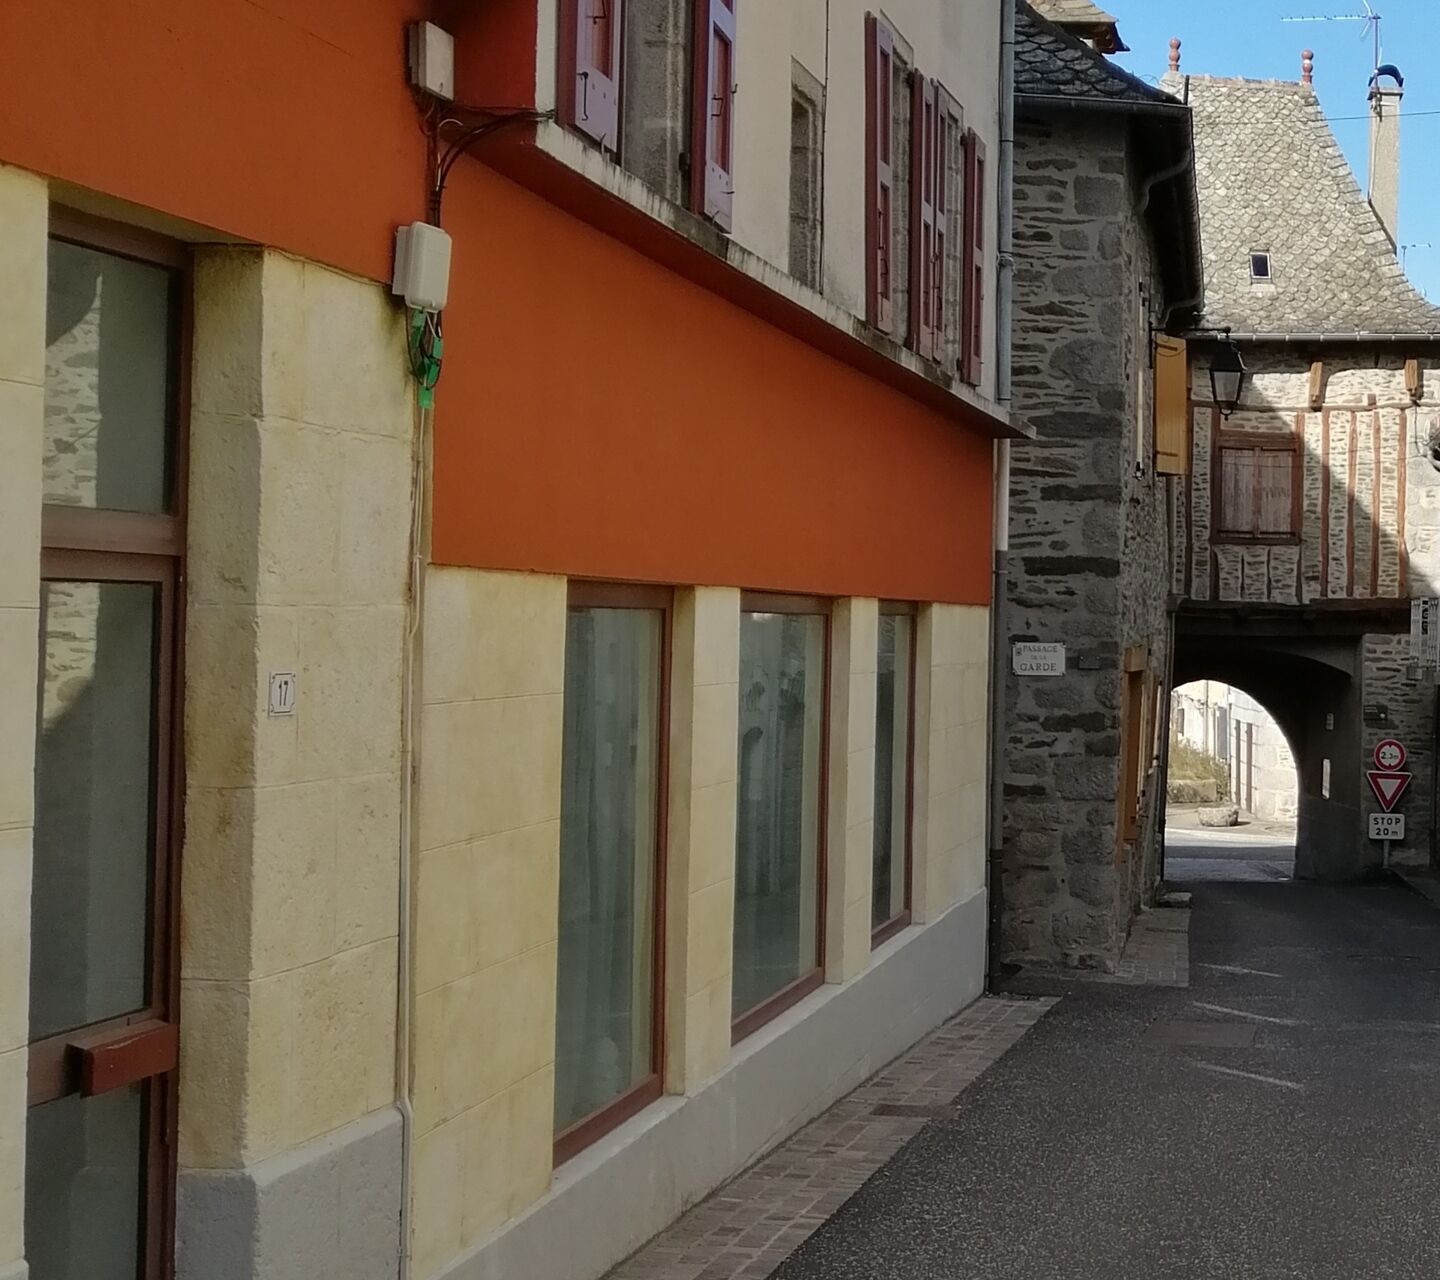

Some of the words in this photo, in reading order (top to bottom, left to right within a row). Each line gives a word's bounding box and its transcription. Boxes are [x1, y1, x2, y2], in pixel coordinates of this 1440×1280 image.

[1023, 645, 1058, 653] PASSAGE
[1020, 663, 1057, 672] GARDE
[278, 680, 289, 707] 17
[1373, 817, 1401, 826] STOP
[1375, 827, 1390, 836] 20
